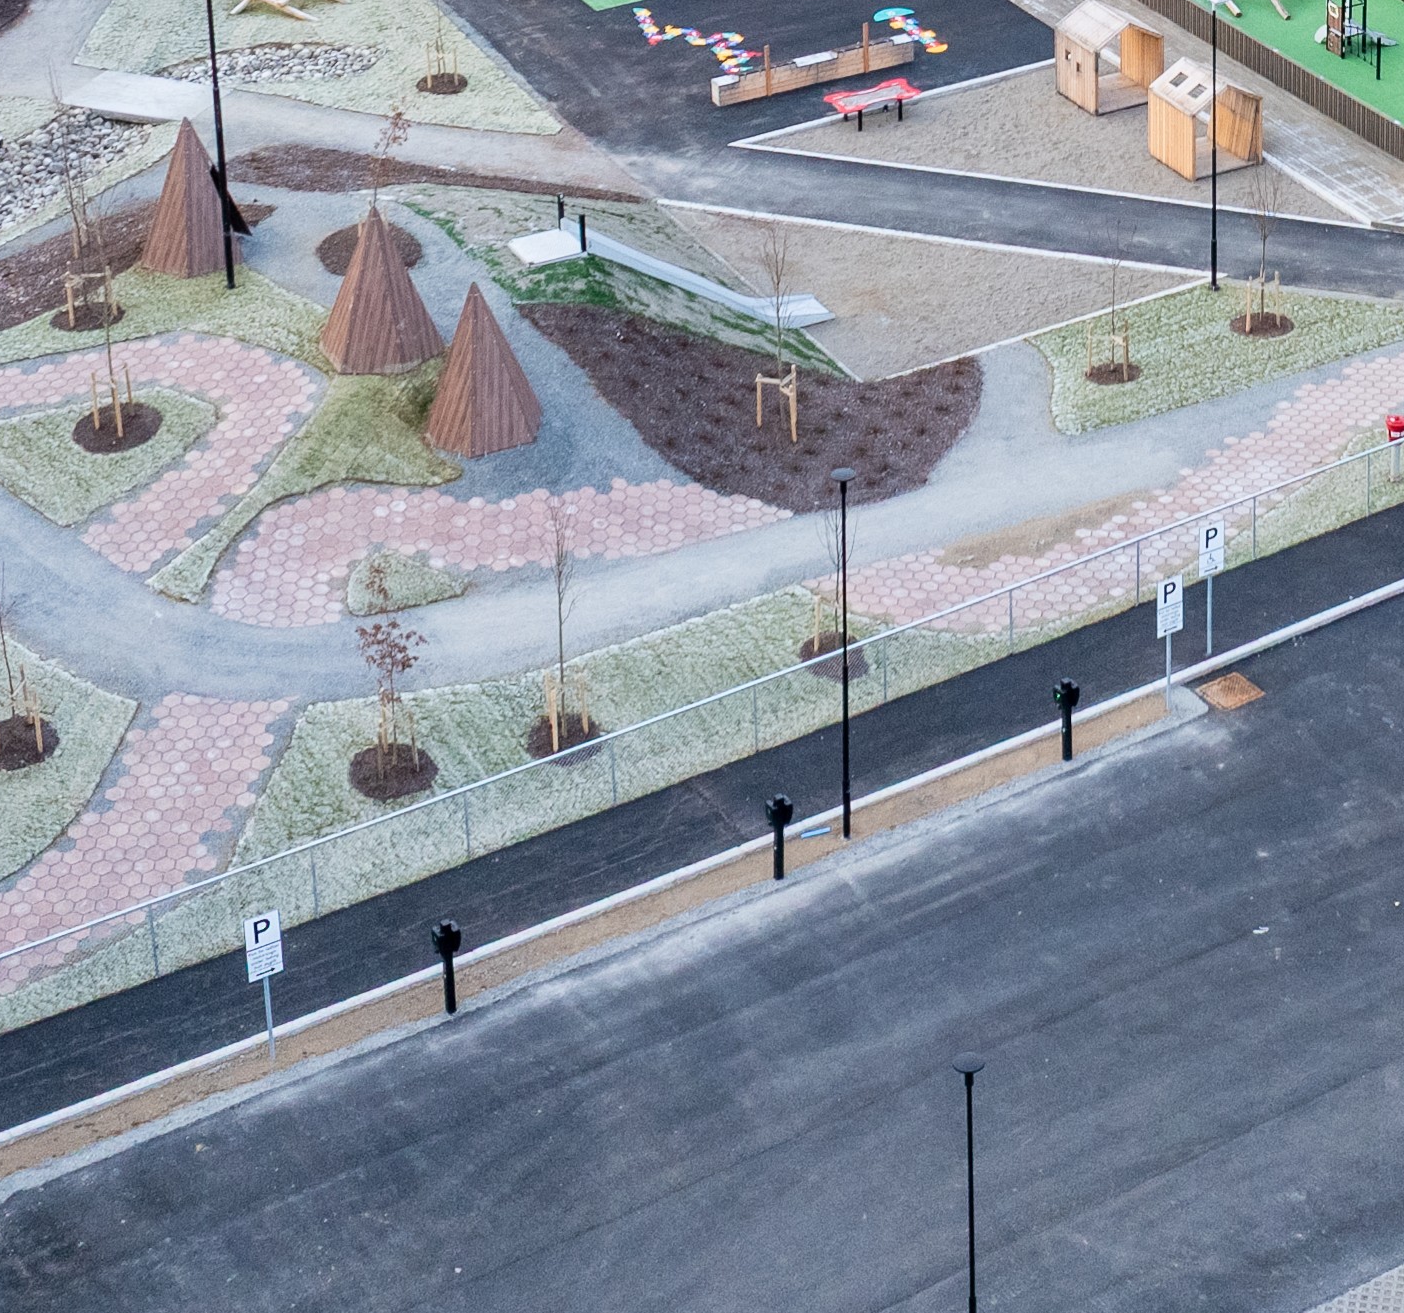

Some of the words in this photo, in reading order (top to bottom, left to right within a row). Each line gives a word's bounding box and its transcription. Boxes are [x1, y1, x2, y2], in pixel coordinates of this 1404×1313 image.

[1205, 527, 1218, 549] P
[1163, 581, 1176, 604] P
[253, 918, 270, 944] P
